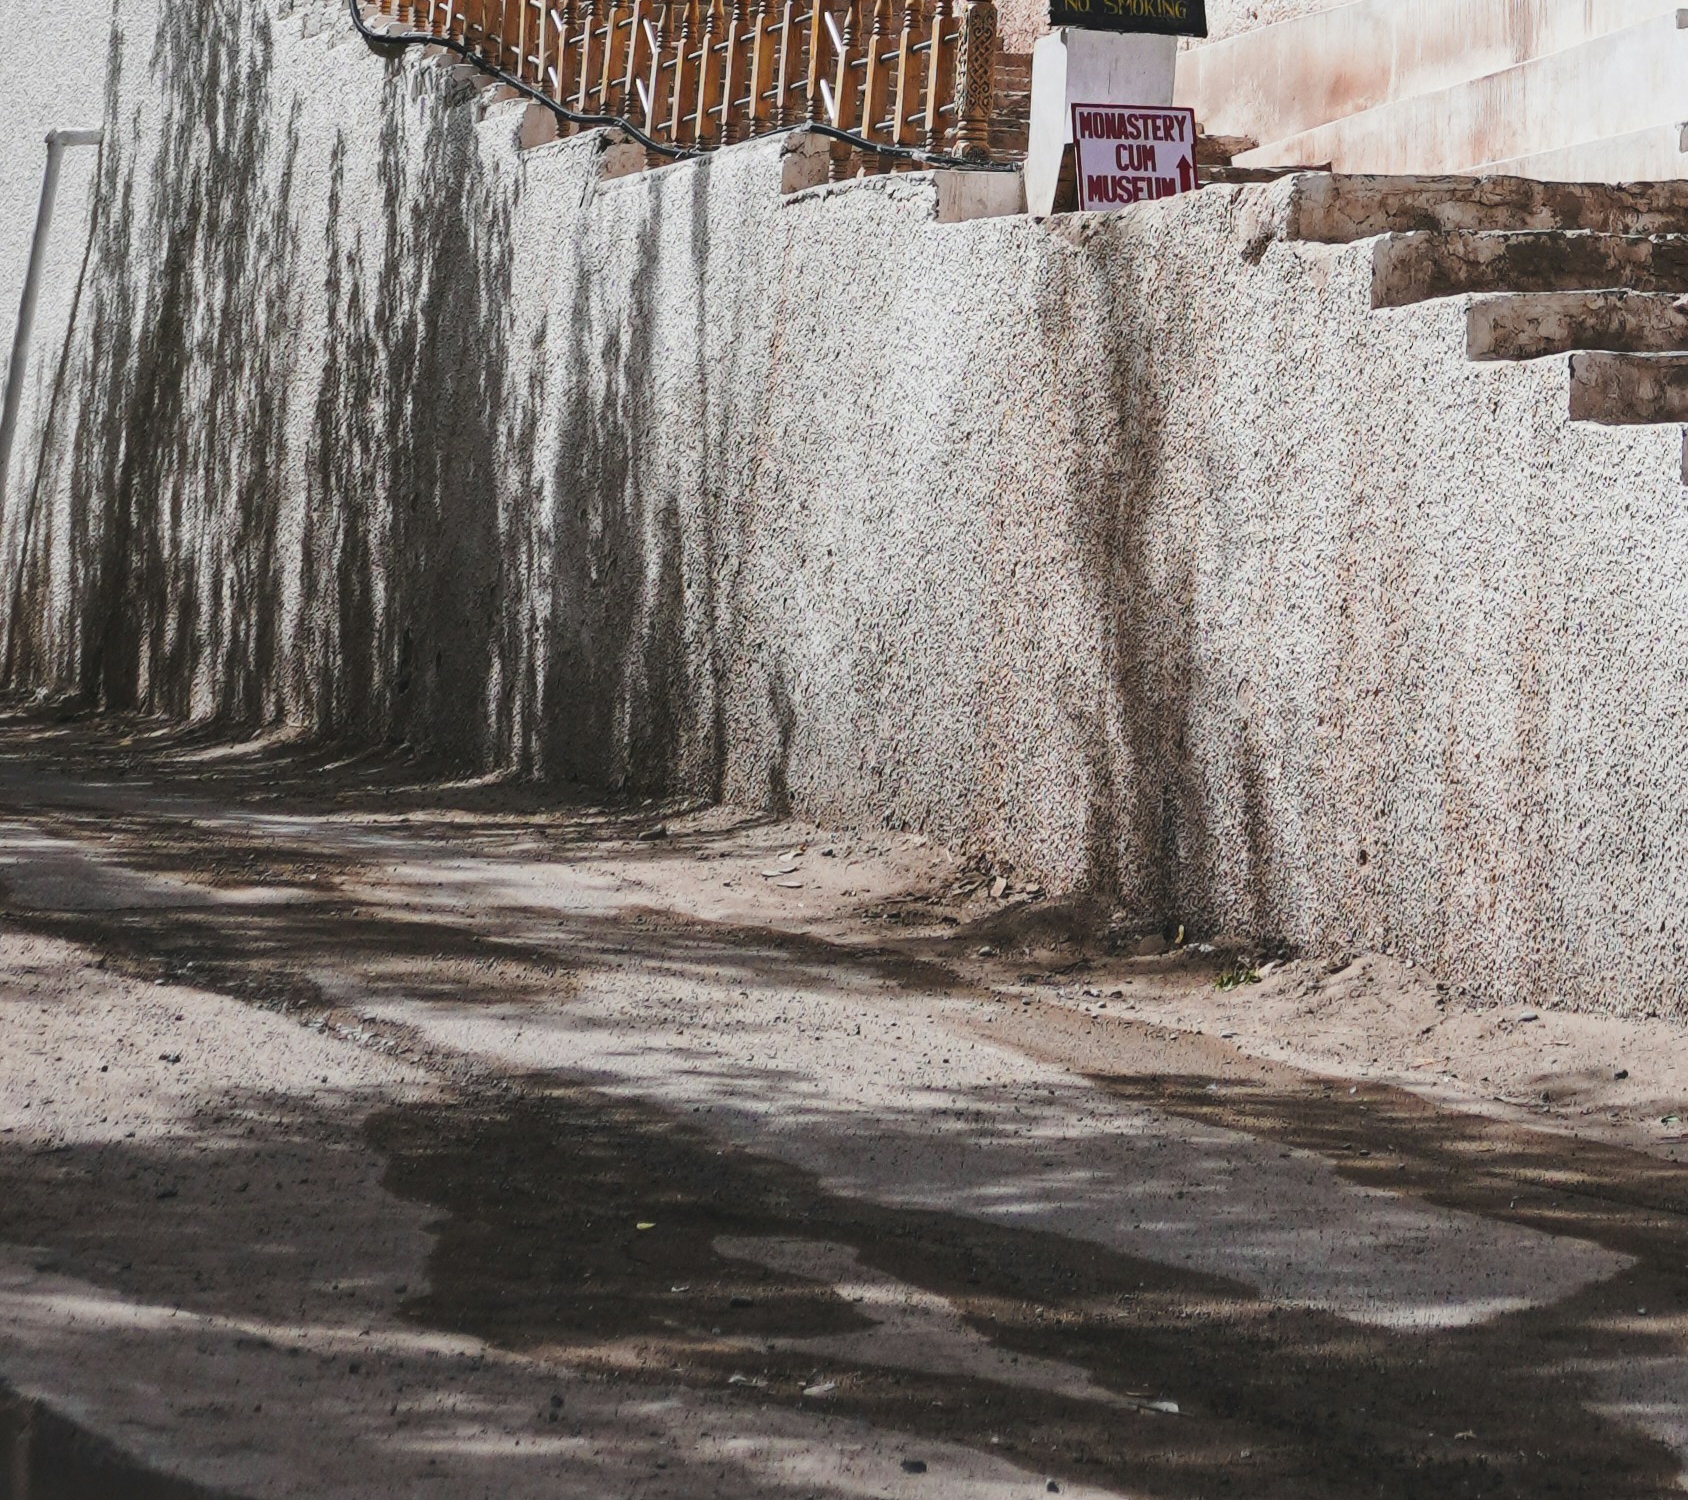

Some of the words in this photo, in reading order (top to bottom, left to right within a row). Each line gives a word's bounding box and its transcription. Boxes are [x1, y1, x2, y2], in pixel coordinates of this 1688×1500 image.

[1079, 111, 1187, 142] MONASTERY
[1115, 143, 1157, 172] CUM
[1087, 174, 1177, 204] MUSEUM
